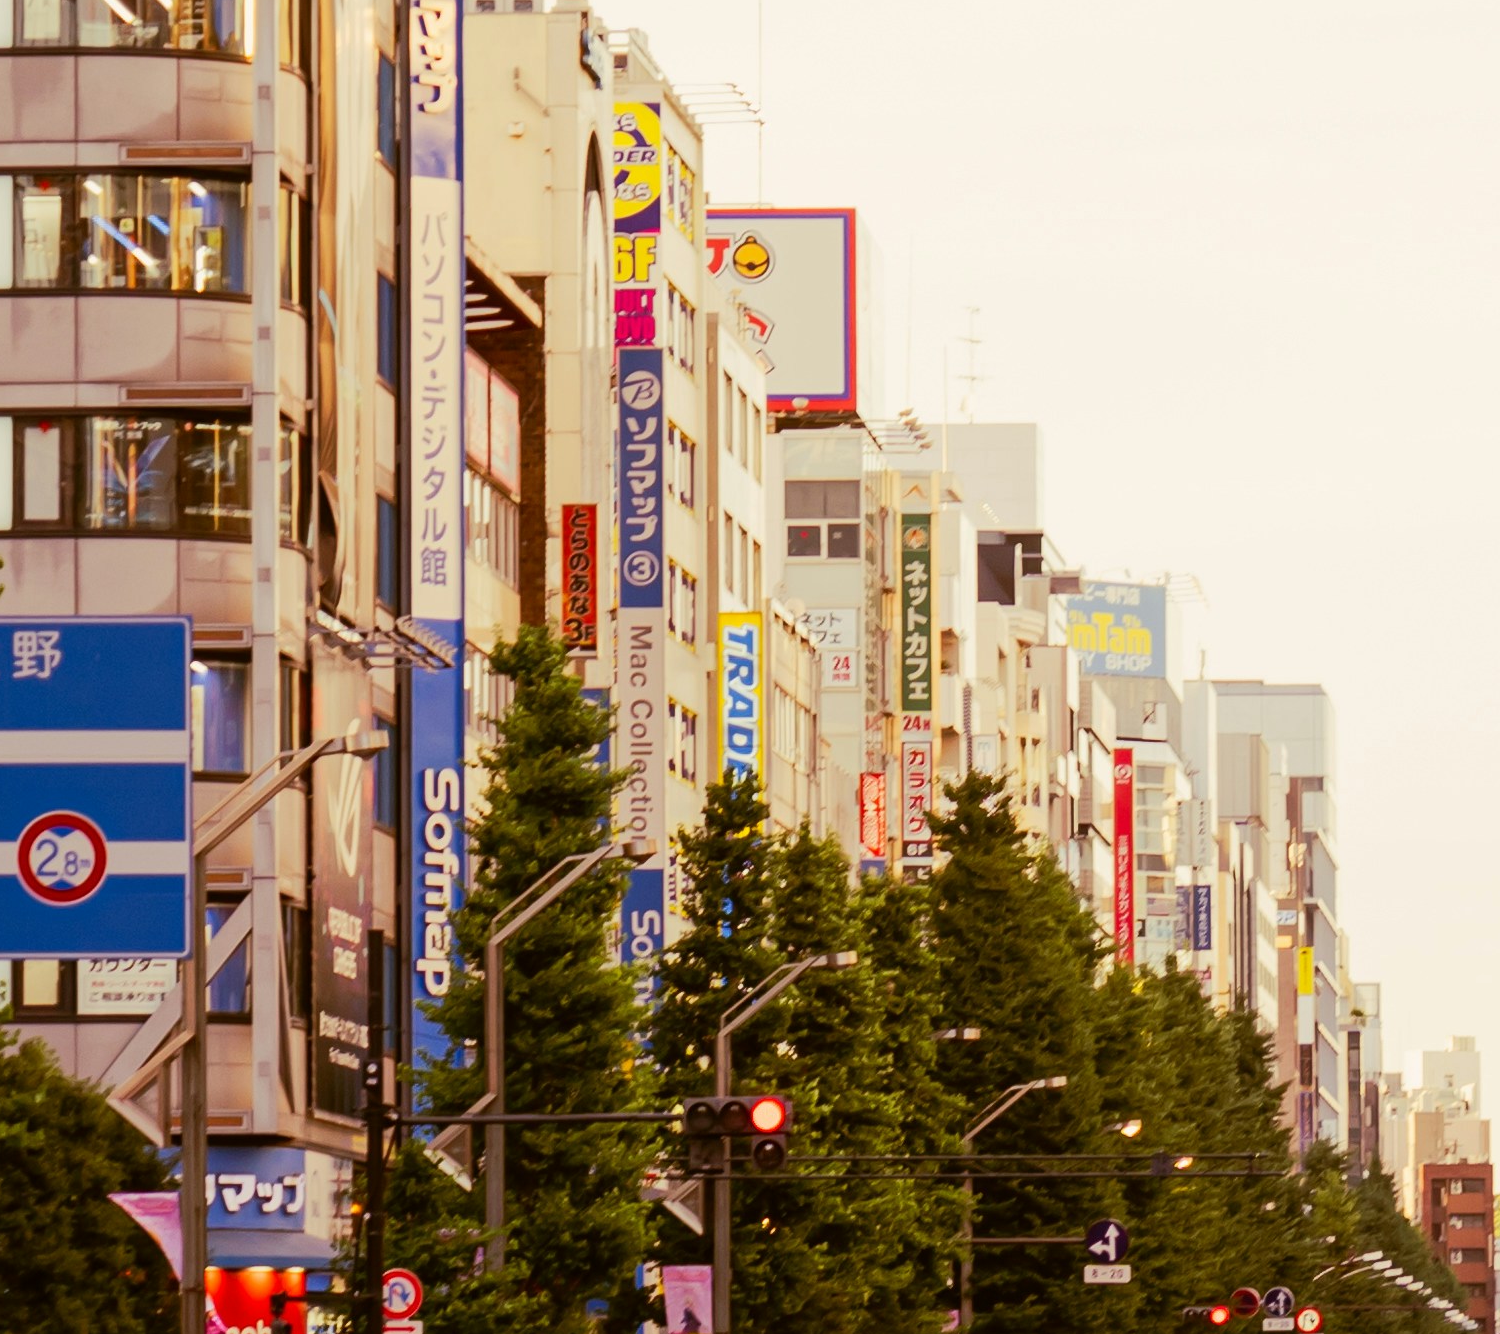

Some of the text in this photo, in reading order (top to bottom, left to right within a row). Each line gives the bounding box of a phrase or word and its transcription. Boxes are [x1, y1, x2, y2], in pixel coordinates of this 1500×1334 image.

[419, 213, 449, 587] パソコン・デジタル館
[625, 417, 658, 542] ソフマップ
[568, 505, 591, 616] とらのあな
[564, 618, 597, 643] 3F
[629, 625, 653, 688] Mac
[903, 560, 931, 700] ネットカフェ
[907, 748, 926, 833] カラオケ
[415, 767, 461, 997] Sofmap
